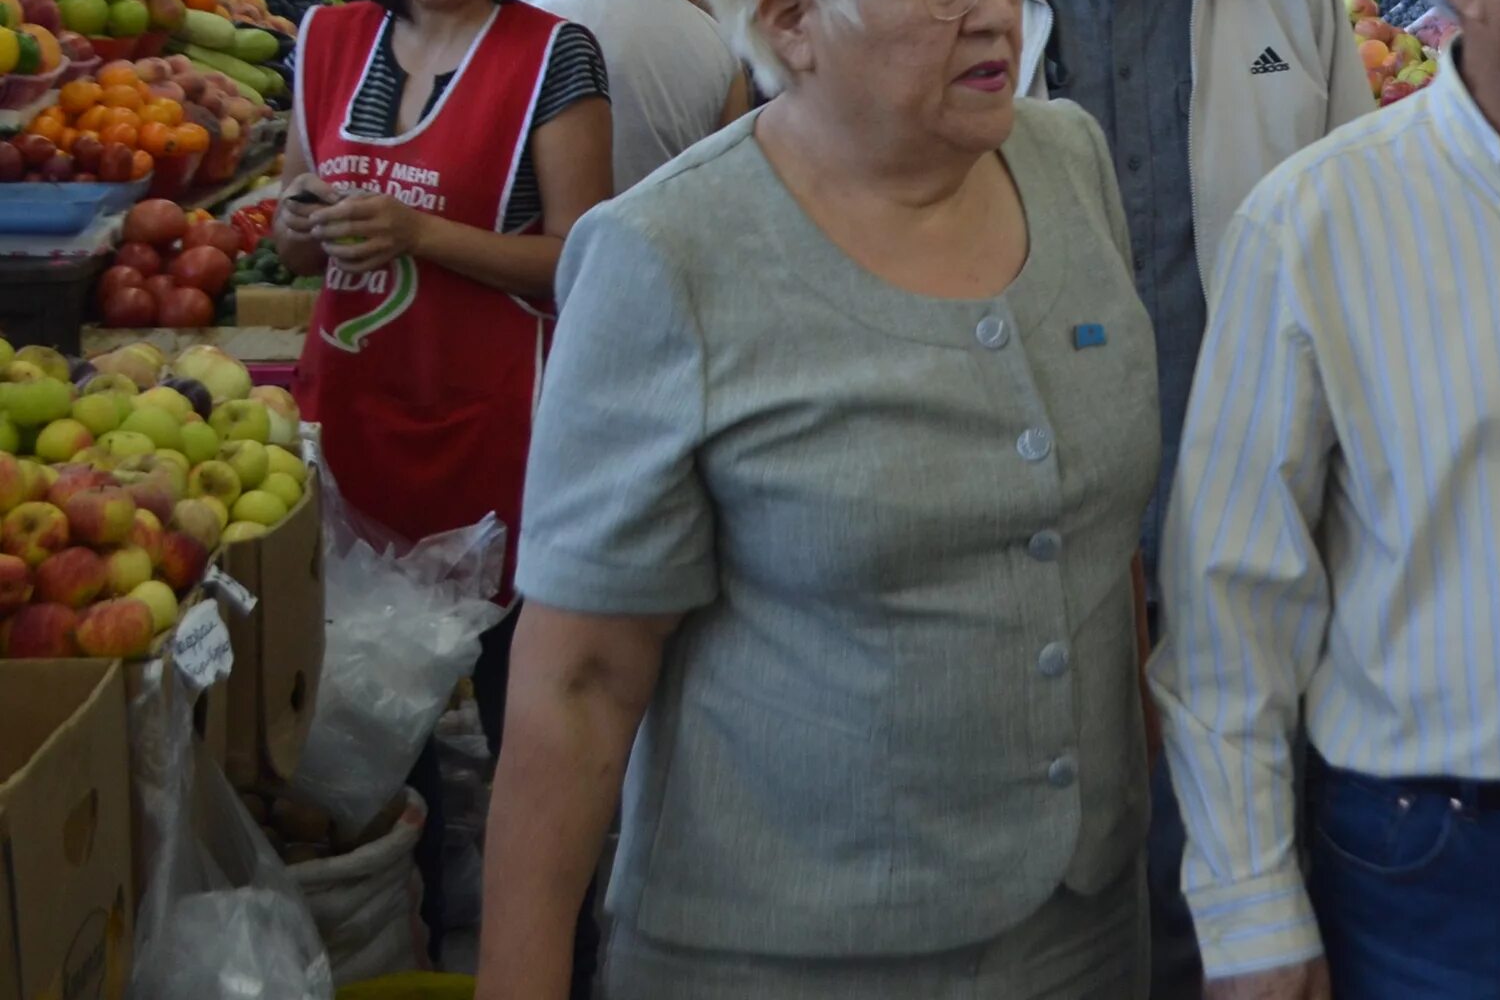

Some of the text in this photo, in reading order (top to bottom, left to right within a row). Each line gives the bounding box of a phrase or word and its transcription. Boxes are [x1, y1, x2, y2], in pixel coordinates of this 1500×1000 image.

[1250, 62, 1290, 75] adidas
[375, 158, 389, 176] У
[391, 162, 440, 187] МЕНЯ
